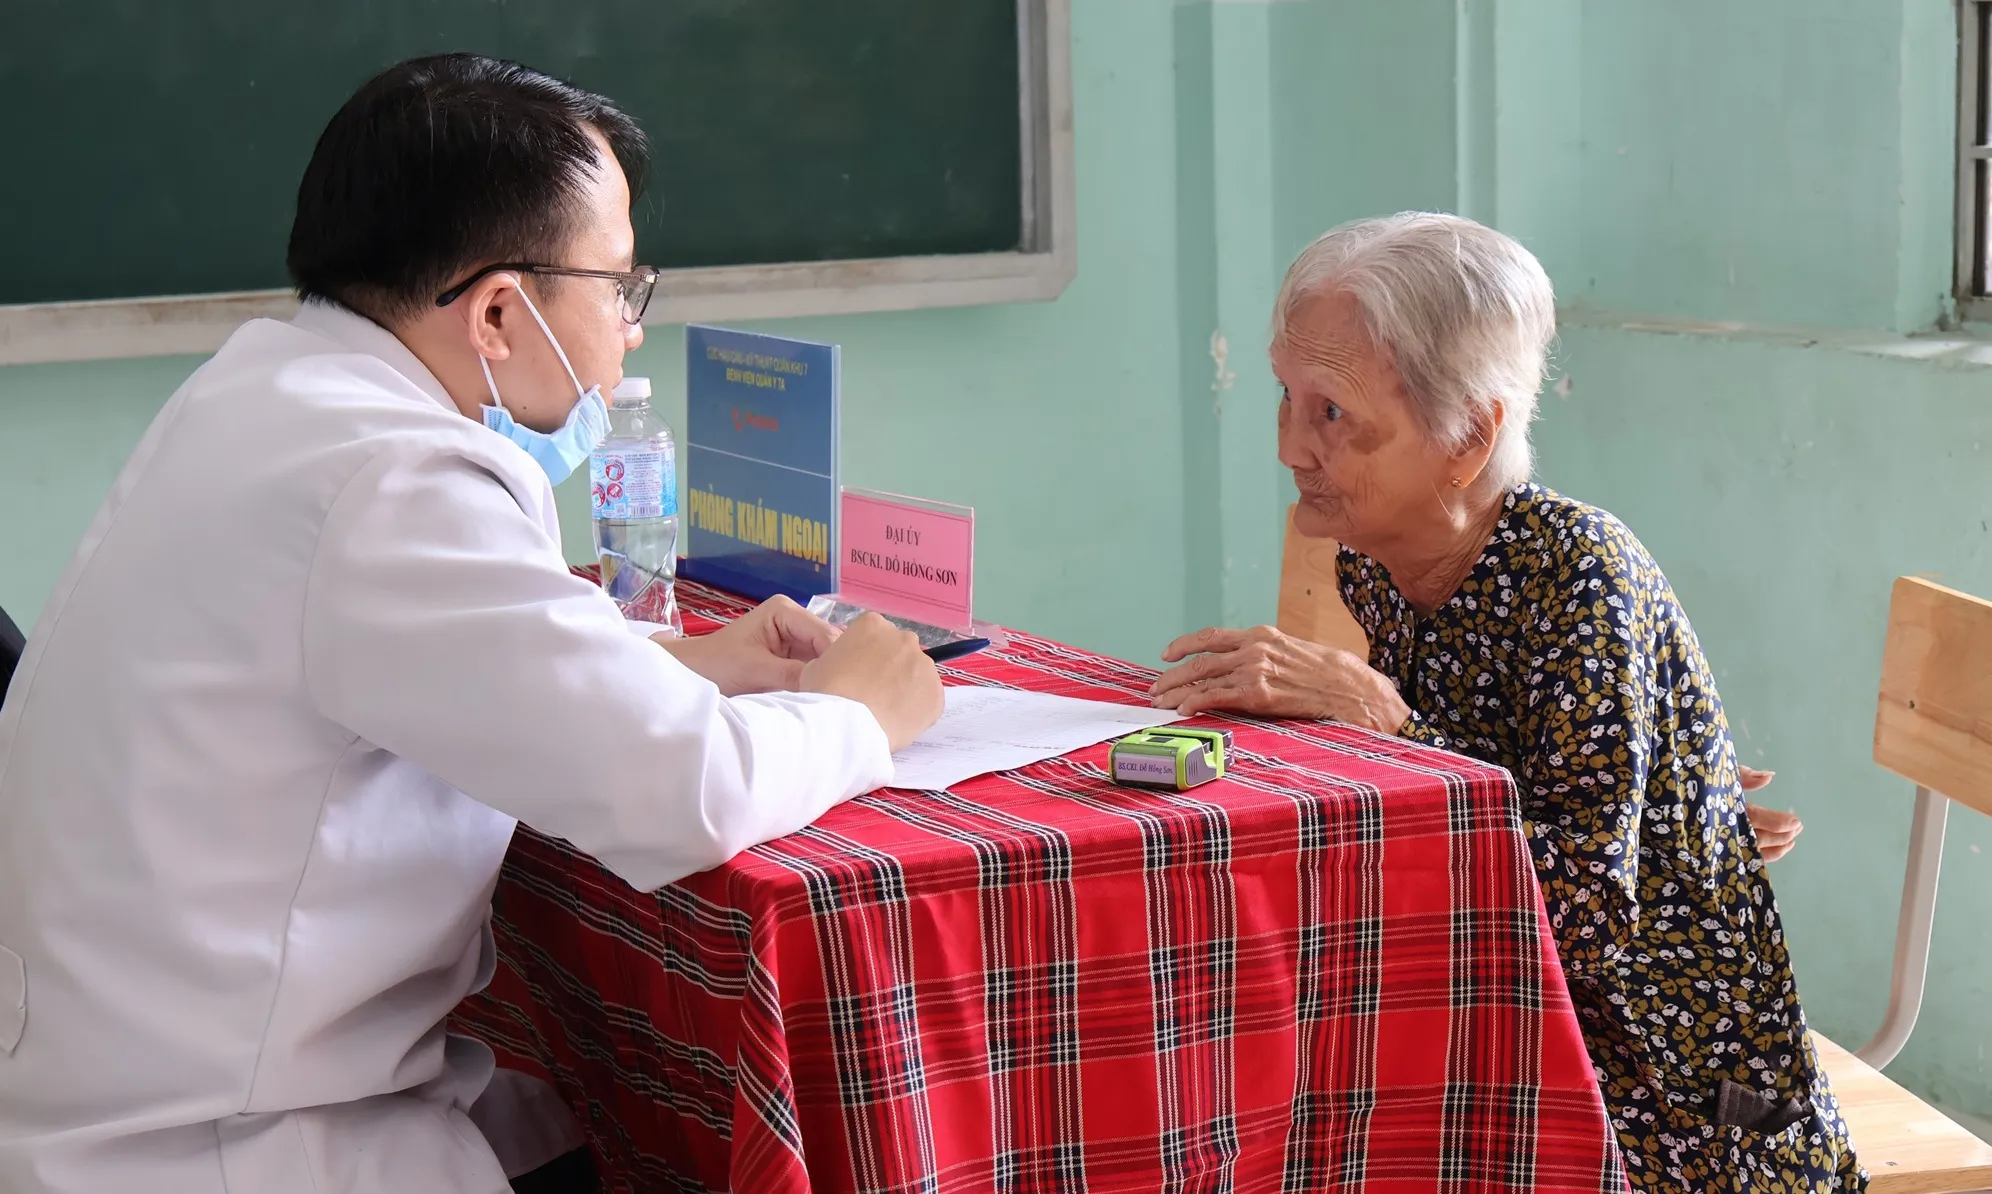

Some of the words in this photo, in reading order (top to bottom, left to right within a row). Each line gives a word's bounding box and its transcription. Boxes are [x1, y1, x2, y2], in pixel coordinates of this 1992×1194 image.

[689, 484, 734, 538] PHÒNG
[737, 497, 778, 551] KHÁM
[781, 512, 828, 573] NGOẠI
[886, 525, 904, 545] ĐẠI
[935, 567, 958, 586] SƠN
